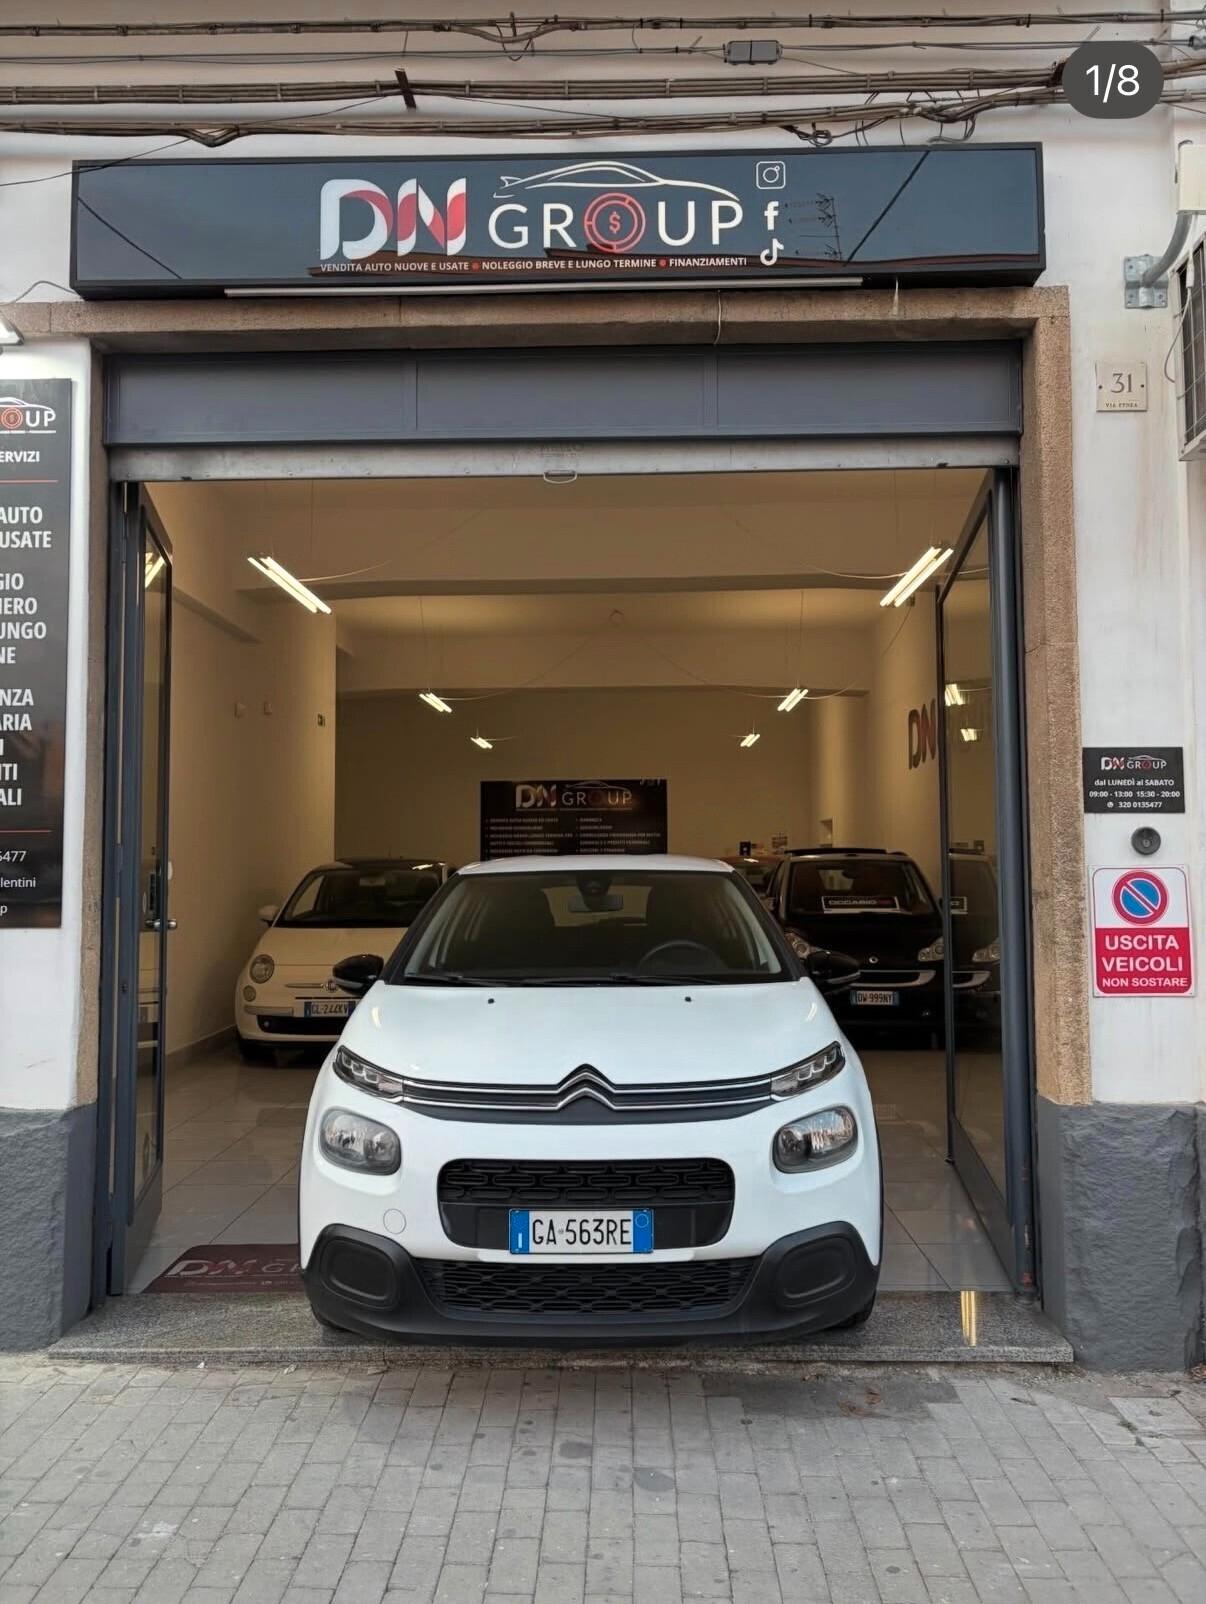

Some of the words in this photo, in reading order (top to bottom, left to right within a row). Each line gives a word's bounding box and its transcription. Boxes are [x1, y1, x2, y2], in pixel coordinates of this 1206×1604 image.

[320, 178, 466, 260] DN
[488, 193, 743, 252] GROUP
[320, 263, 362, 272] VENDITA
[365, 263, 391, 271] AUTO
[394, 262, 428, 271] NUOVE
[431, 262, 436, 270] E
[439, 262, 469, 270] USATE
[482, 260, 533, 270] NOLEGGIO
[536, 260, 565, 269] BREVE
[568, 260, 573, 269] E
[576, 259, 611, 268] LUNGO
[613, 259, 656, 268] TERMINE
[669, 257, 747, 267] FINANZIAMENTI
[1111, 373, 1132, 393] 31
[0, 531, 52, 549] USATE
[1101, 757, 1125, 770] DN
[1126, 760, 1167, 770] GROUP
[1108, 778, 1135, 786] LUNEDÌ
[1105, 935, 1179, 951] USCITA
[1102, 956, 1183, 972] VEICOLI
[1102, 978, 1128, 987] NON
[1131, 977, 1188, 987] SOSTARE
